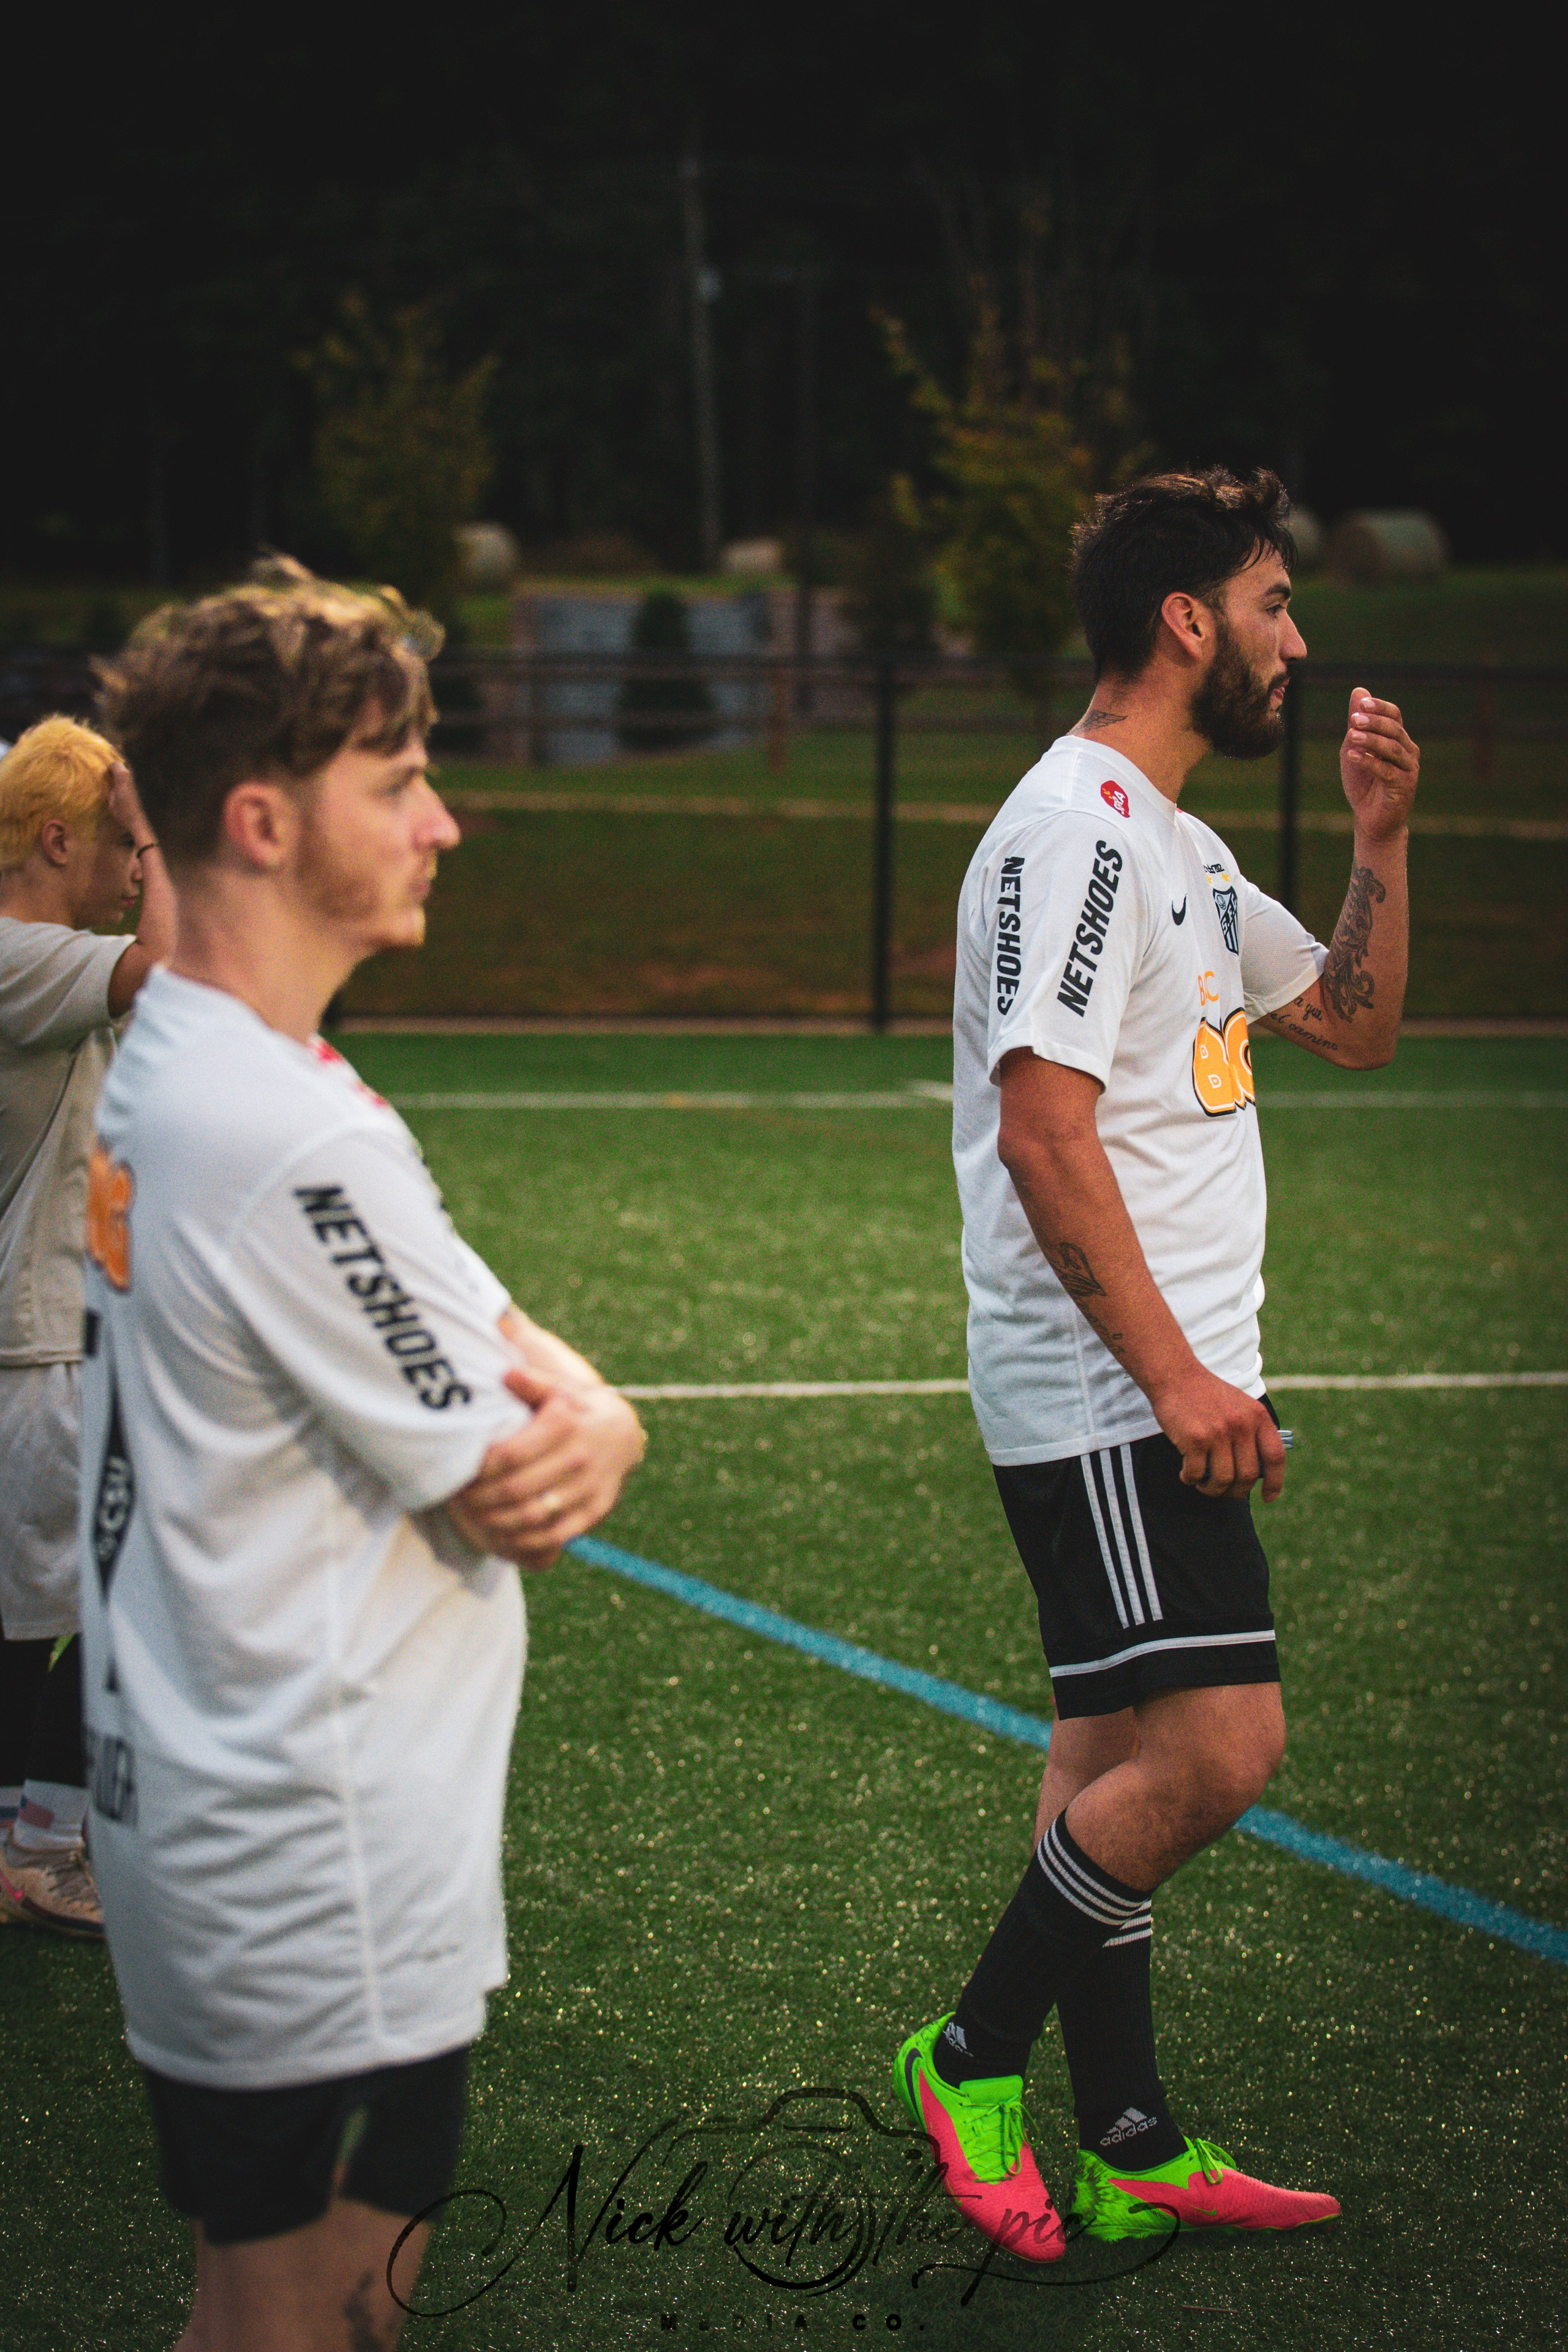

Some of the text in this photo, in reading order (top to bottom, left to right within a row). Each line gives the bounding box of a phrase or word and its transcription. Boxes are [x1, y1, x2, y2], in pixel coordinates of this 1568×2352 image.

[997, 856, 1025, 1016] NETSHOES
[1057, 840, 1123, 1017] NETSHOES
[293, 1184, 473, 1411] NETSHOES
[1100, 2117, 1158, 2146] adidas
